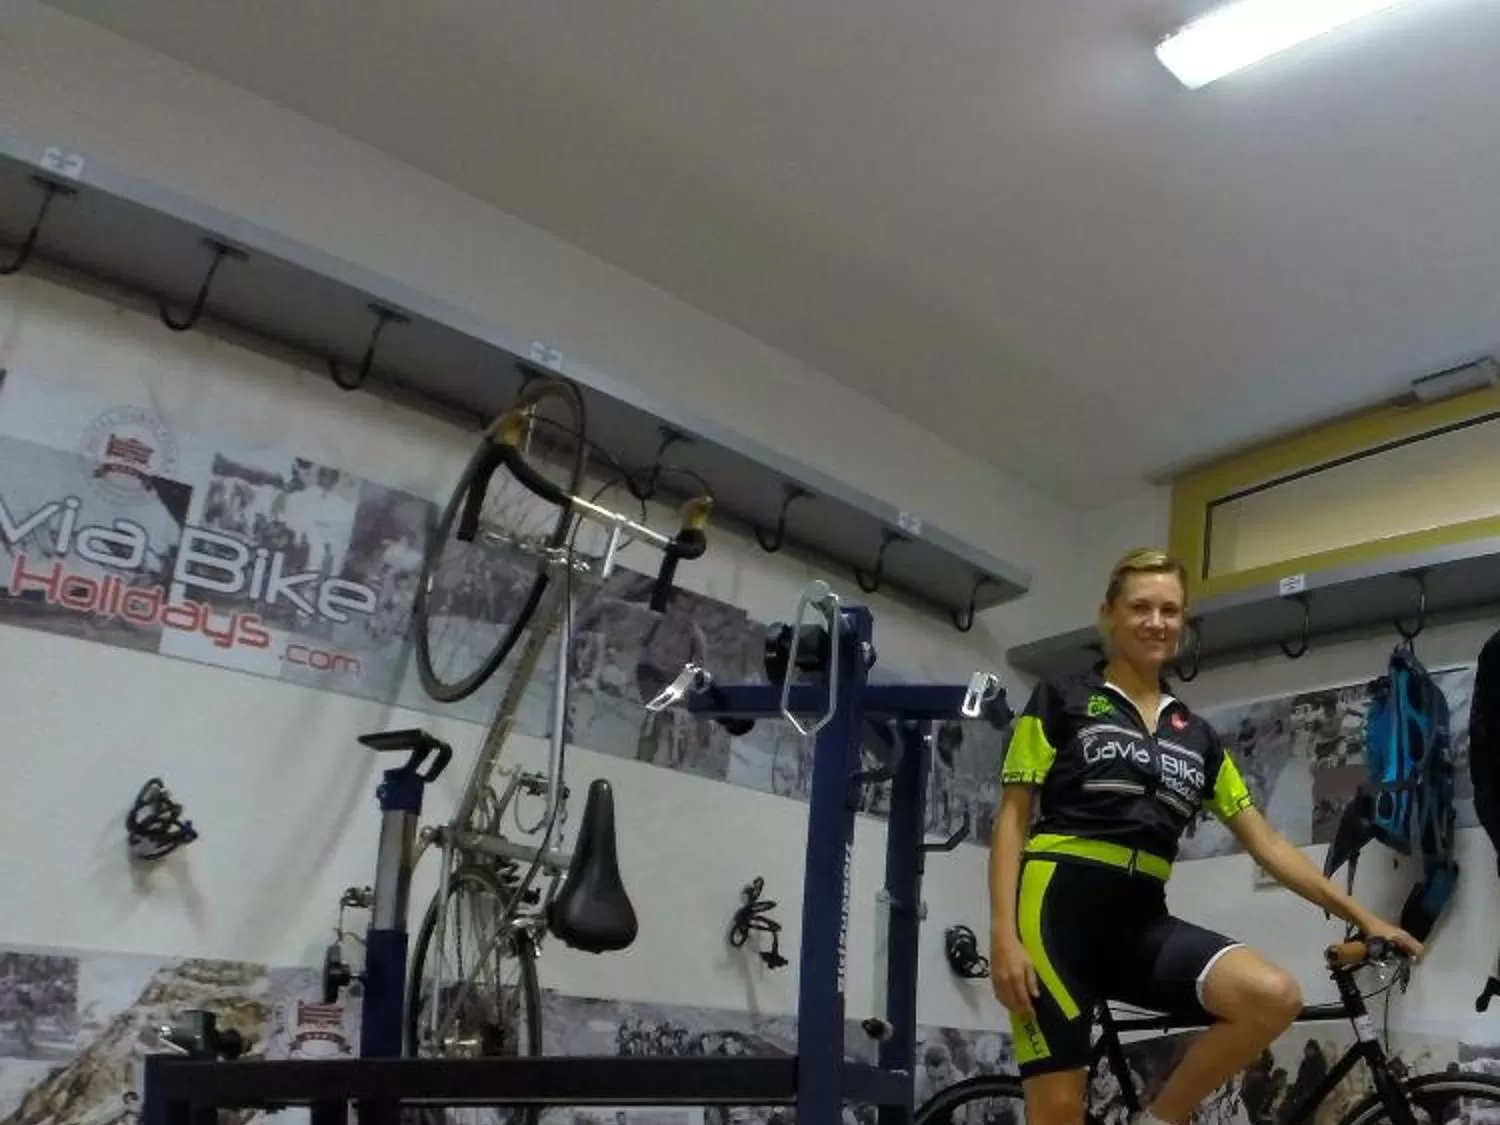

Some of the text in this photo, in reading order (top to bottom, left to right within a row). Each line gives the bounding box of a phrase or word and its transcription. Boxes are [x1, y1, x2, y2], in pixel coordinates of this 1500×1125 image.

[0, 496, 378, 622] via Bike
[8, 552, 271, 648] Holidays
[1161, 753, 1205, 791] Bike
